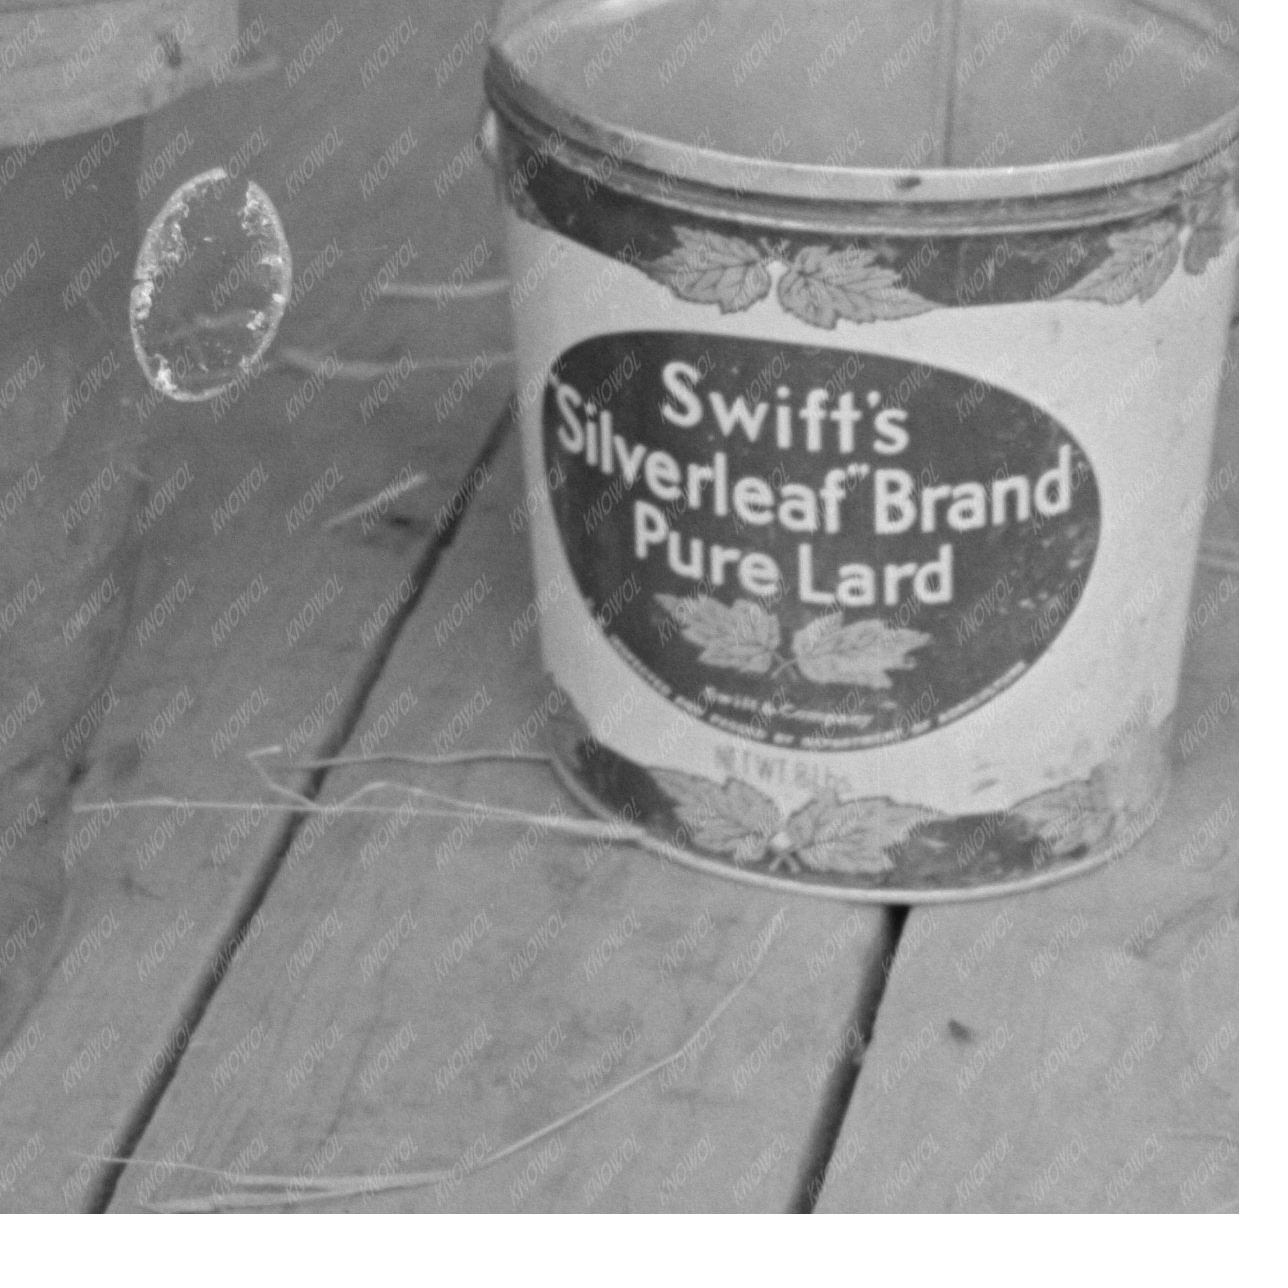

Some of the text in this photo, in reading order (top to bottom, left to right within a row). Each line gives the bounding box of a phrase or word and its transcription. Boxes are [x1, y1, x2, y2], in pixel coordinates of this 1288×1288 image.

[663, 361, 910, 454] Swift's
[874, 443, 1071, 535] Brand
[634, 500, 953, 606] Pure Lard
